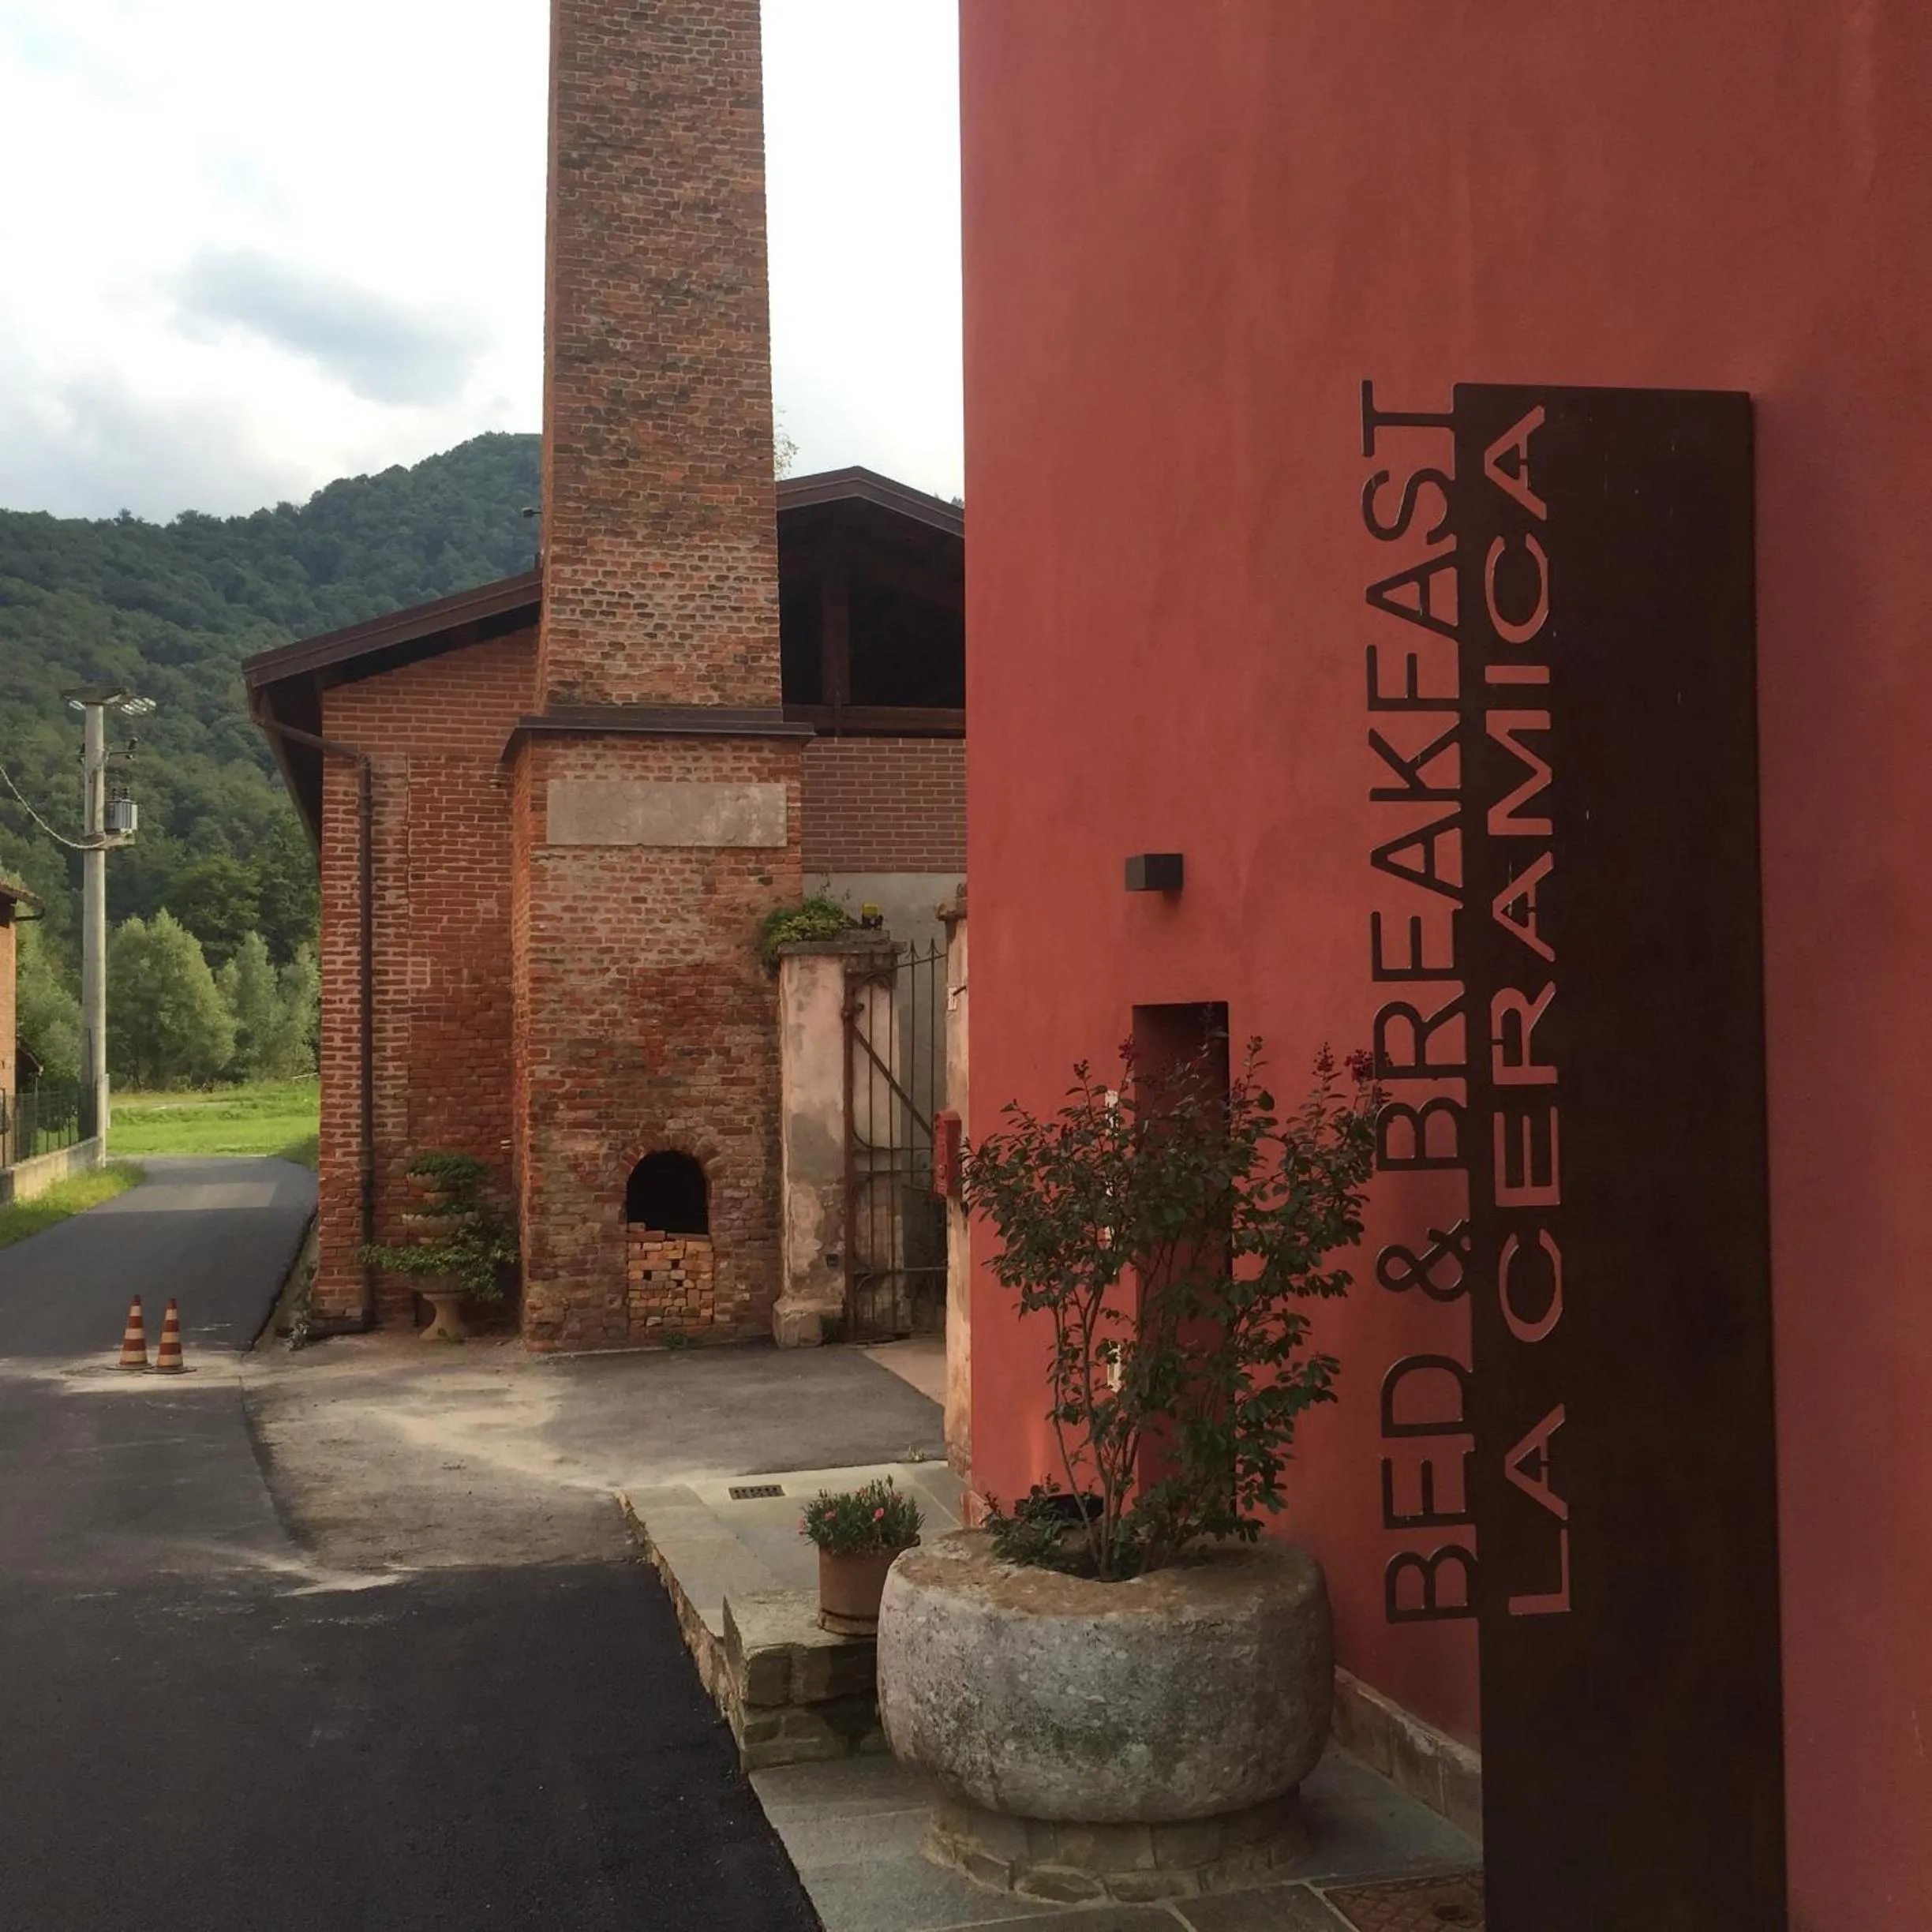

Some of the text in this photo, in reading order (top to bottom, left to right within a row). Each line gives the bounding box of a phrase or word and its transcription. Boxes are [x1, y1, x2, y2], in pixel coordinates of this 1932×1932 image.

[1361, 380, 1478, 1625] BED & BREAKFAST
[1484, 404, 1571, 1616] LA CERAMICA
